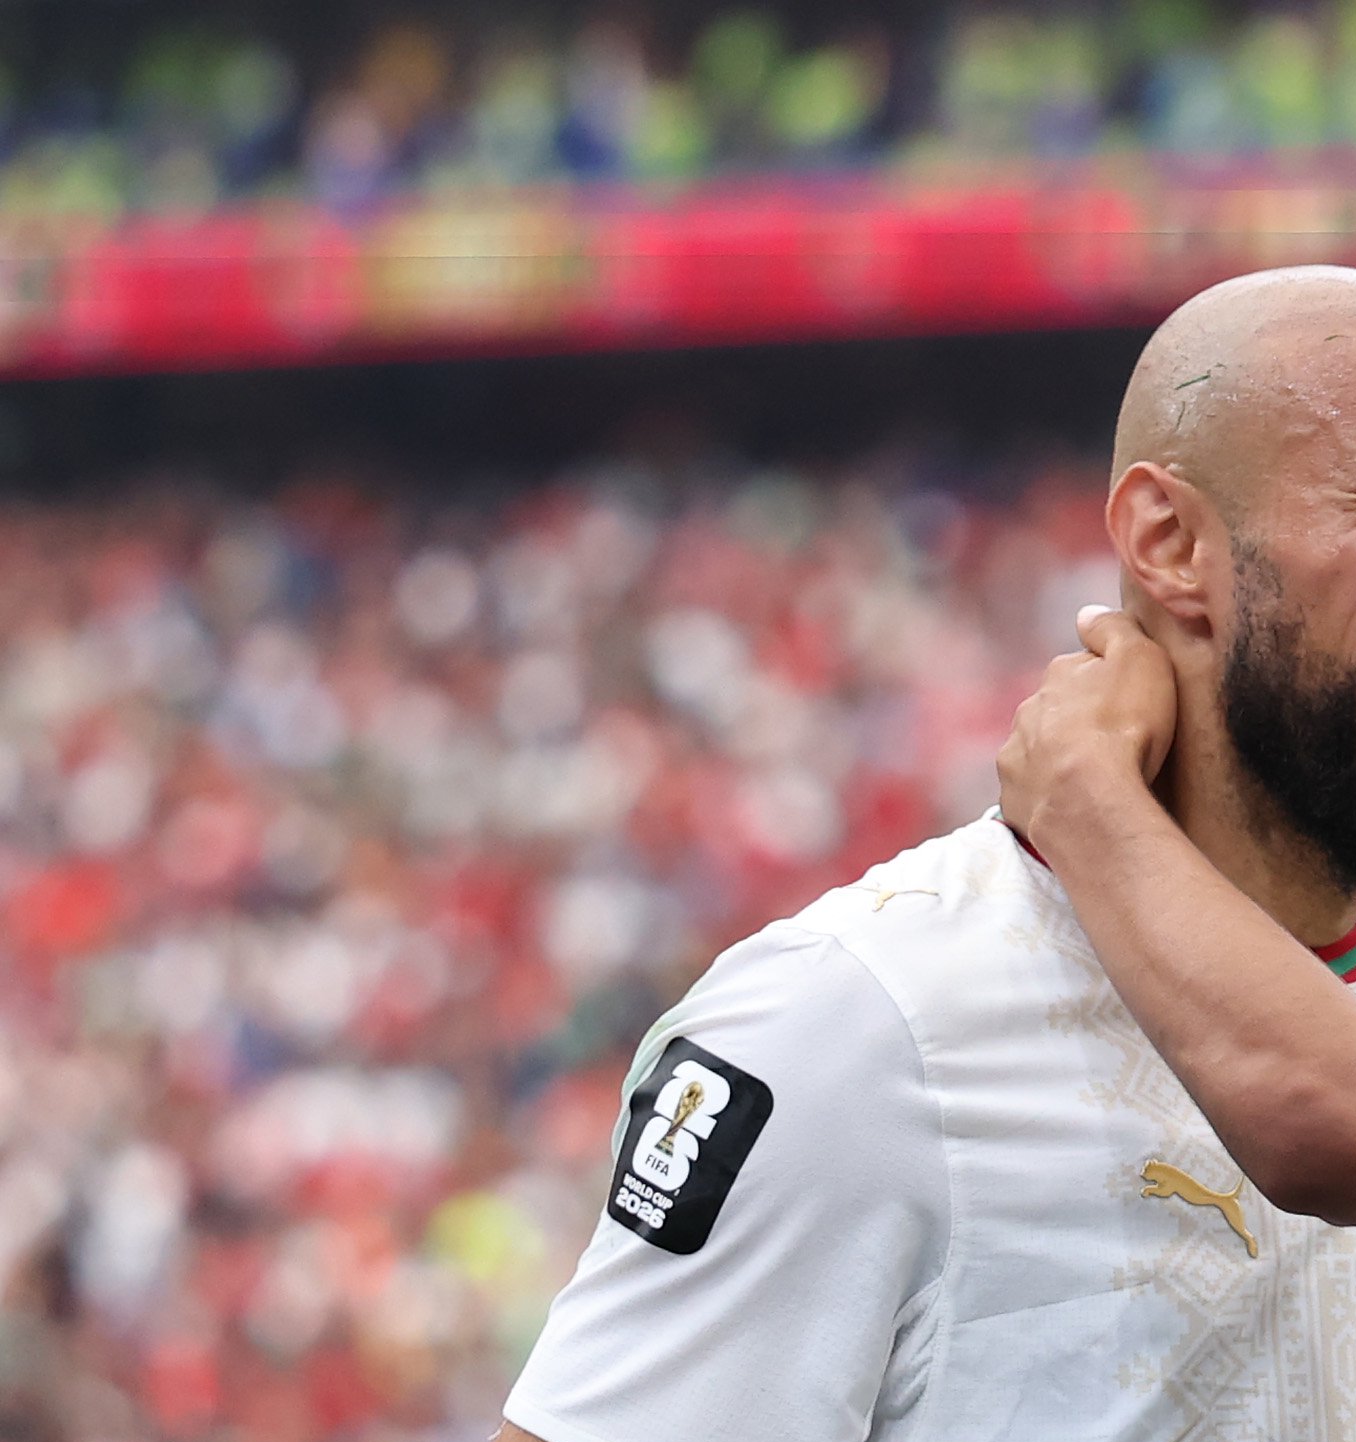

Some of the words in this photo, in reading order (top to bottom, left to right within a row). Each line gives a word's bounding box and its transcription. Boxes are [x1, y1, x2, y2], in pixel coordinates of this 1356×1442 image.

[645, 1154, 671, 1177] FIFA
[615, 1188, 666, 1230] 2026
[622, 1172, 654, 1202] WORLD
[652, 1190, 674, 1211] CUP
